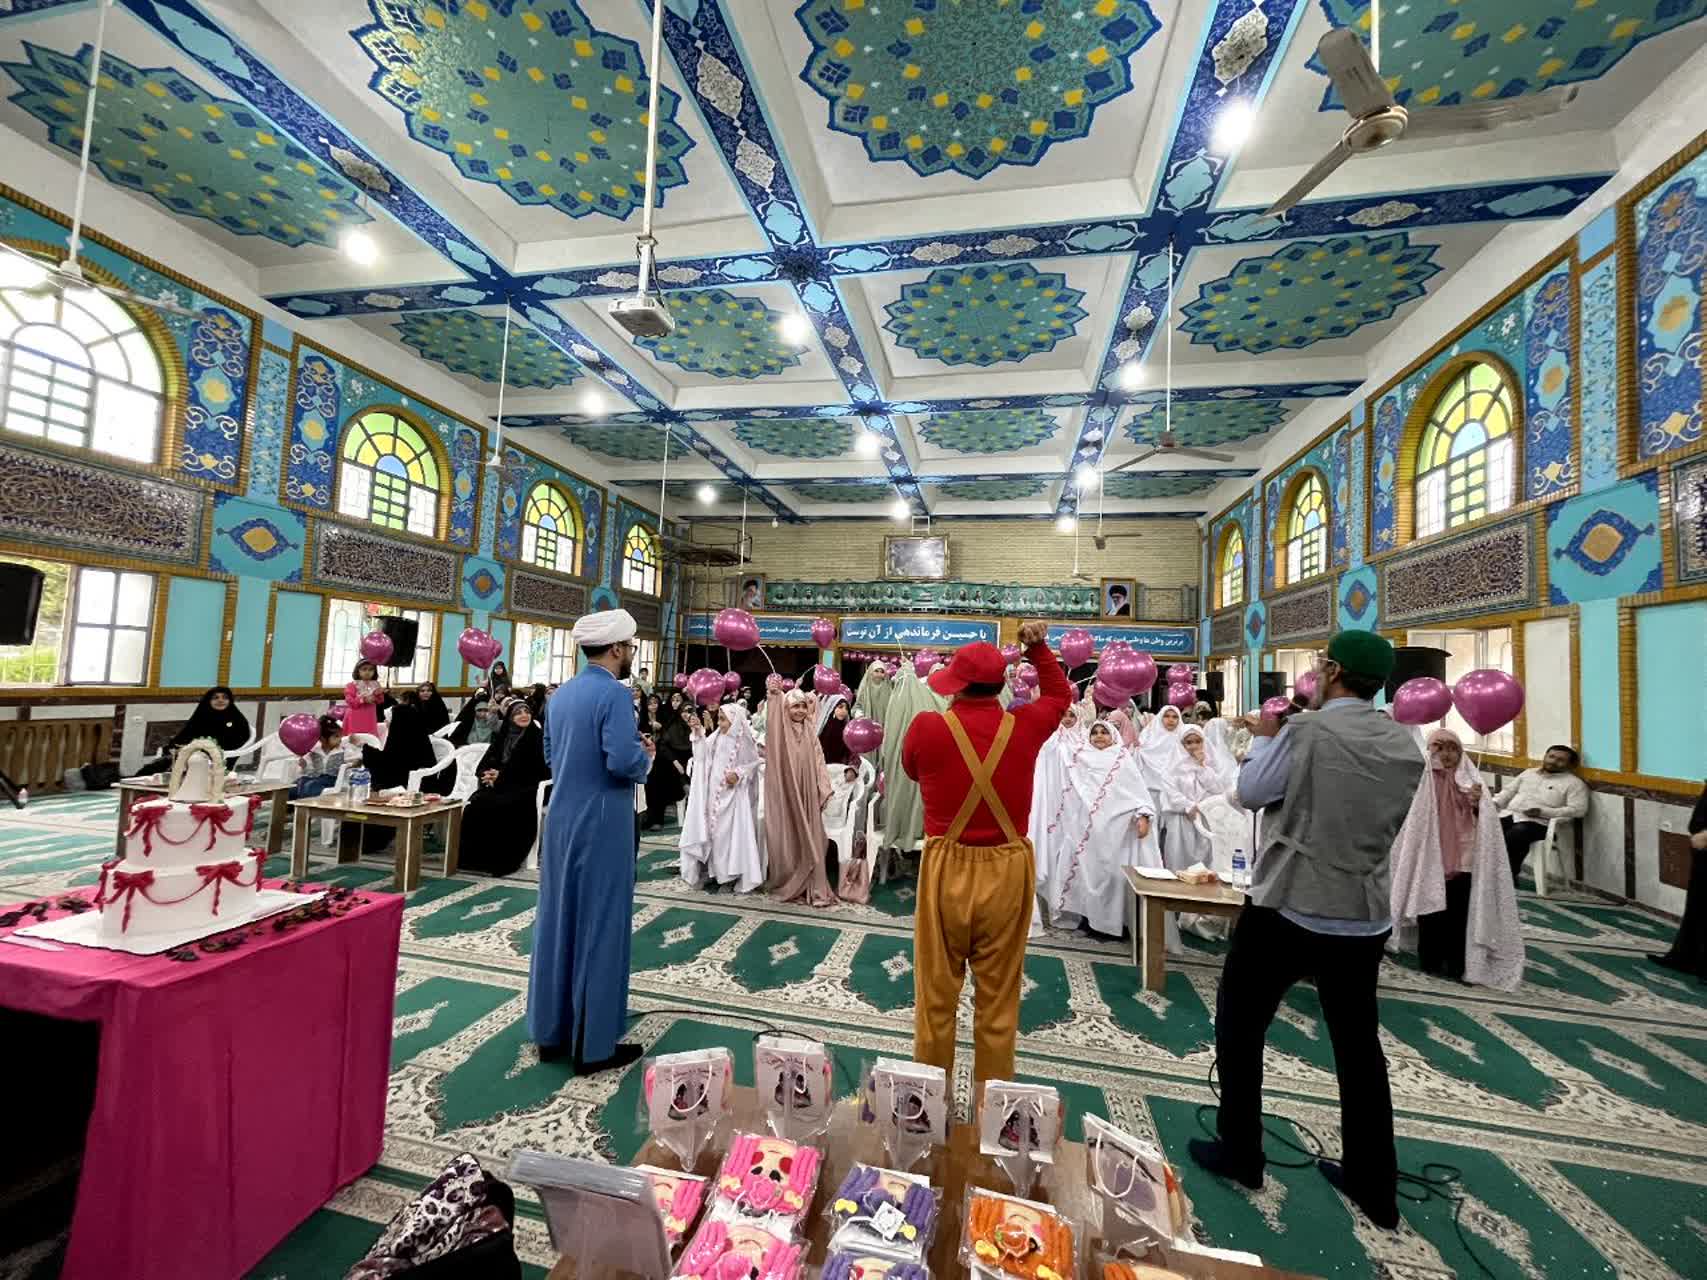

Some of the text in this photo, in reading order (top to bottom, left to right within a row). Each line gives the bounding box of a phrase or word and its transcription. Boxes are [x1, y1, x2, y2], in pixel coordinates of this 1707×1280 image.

[846, 624, 987, 641] یا حسین فرماندهی از آن توست
